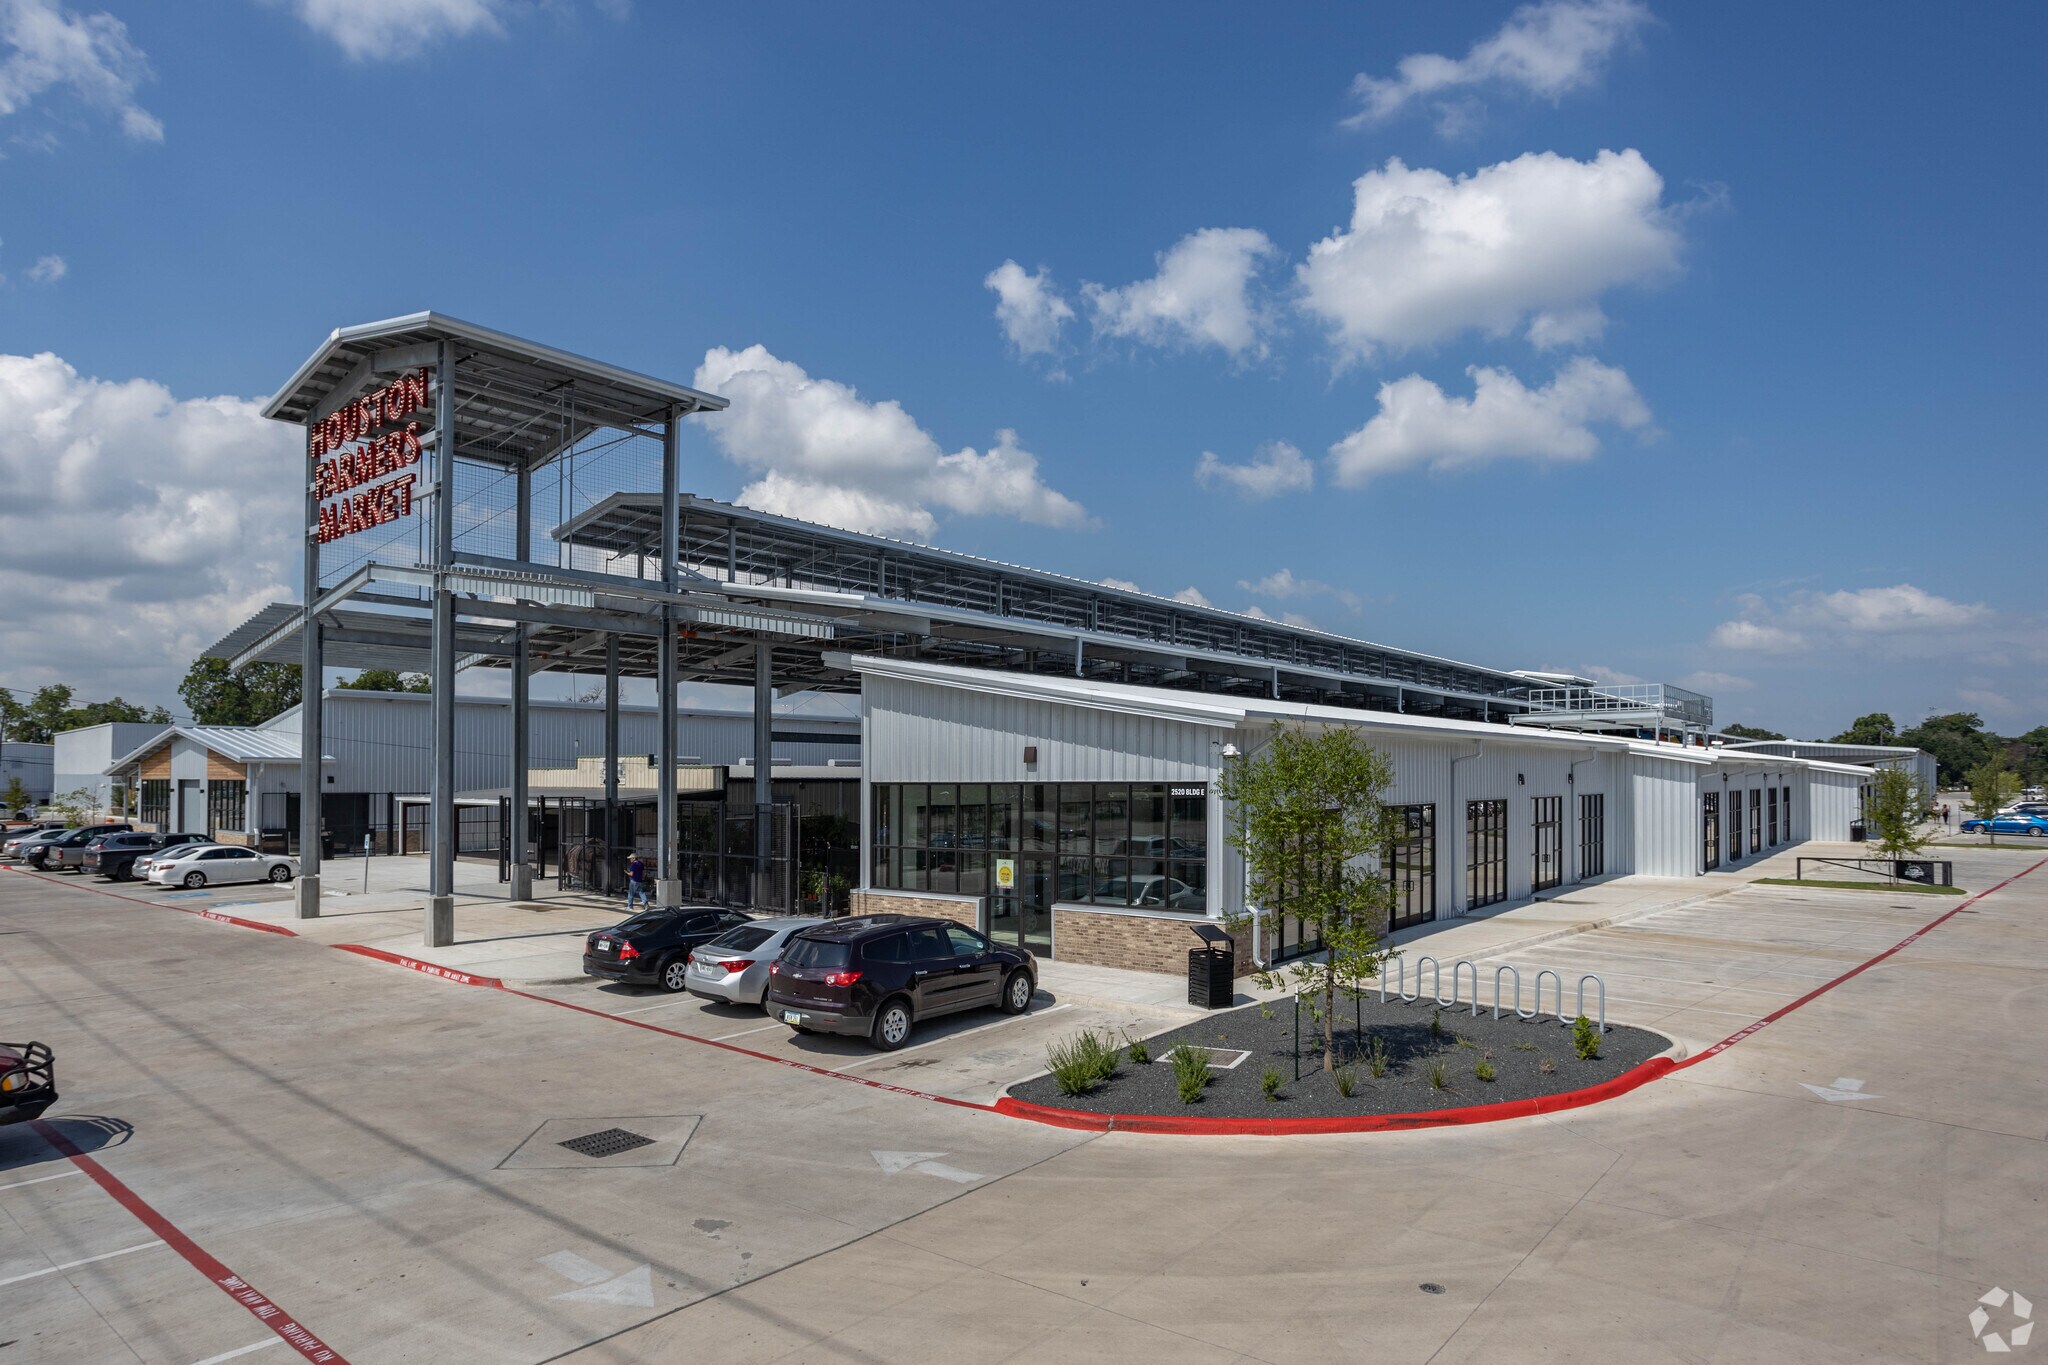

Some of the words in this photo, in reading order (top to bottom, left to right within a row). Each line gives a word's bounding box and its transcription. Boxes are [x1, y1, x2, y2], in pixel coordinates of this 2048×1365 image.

[311, 367, 428, 458] HOUSTON
[315, 421, 422, 502] FARMERS
[317, 473, 416, 544] MARKET
[1171, 788, 1185, 796] 2520
[1185, 788, 1200, 796] BLDG
[1201, 788, 1205, 796] E
[218, 1275, 248, 1292] ZONE
[236, 1289, 266, 1306] AWAY
[253, 1303, 280, 1320] TOW
[279, 1322, 322, 1352] PARKING
[313, 1349, 336, 1363] NO
